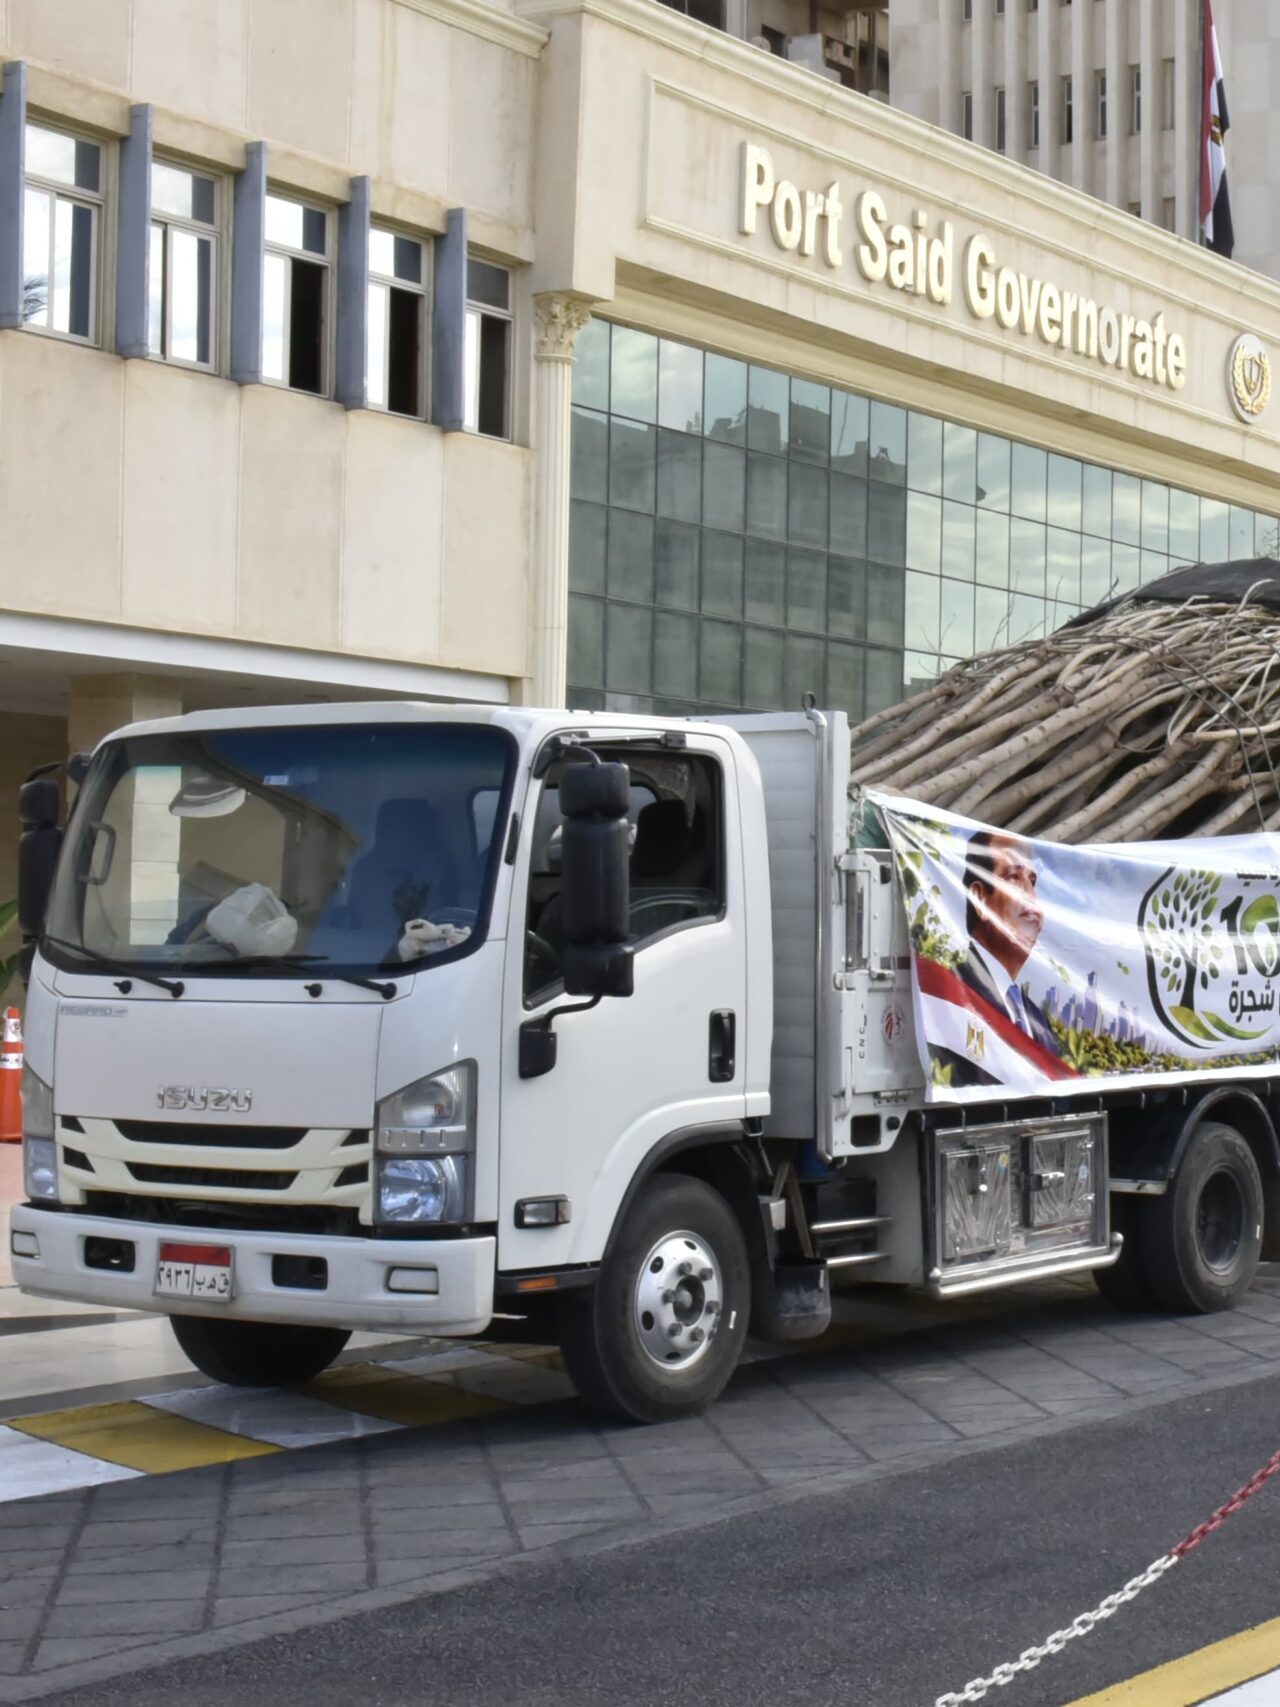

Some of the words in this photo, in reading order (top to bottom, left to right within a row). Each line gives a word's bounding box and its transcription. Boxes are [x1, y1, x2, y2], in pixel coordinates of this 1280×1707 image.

[738, 140, 843, 269] Port
[856, 190, 954, 305] Said
[962, 233, 1187, 390] Governorate
[1229, 979, 1275, 1022] شجرة
[157, 1084, 252, 1113] ISUZU
